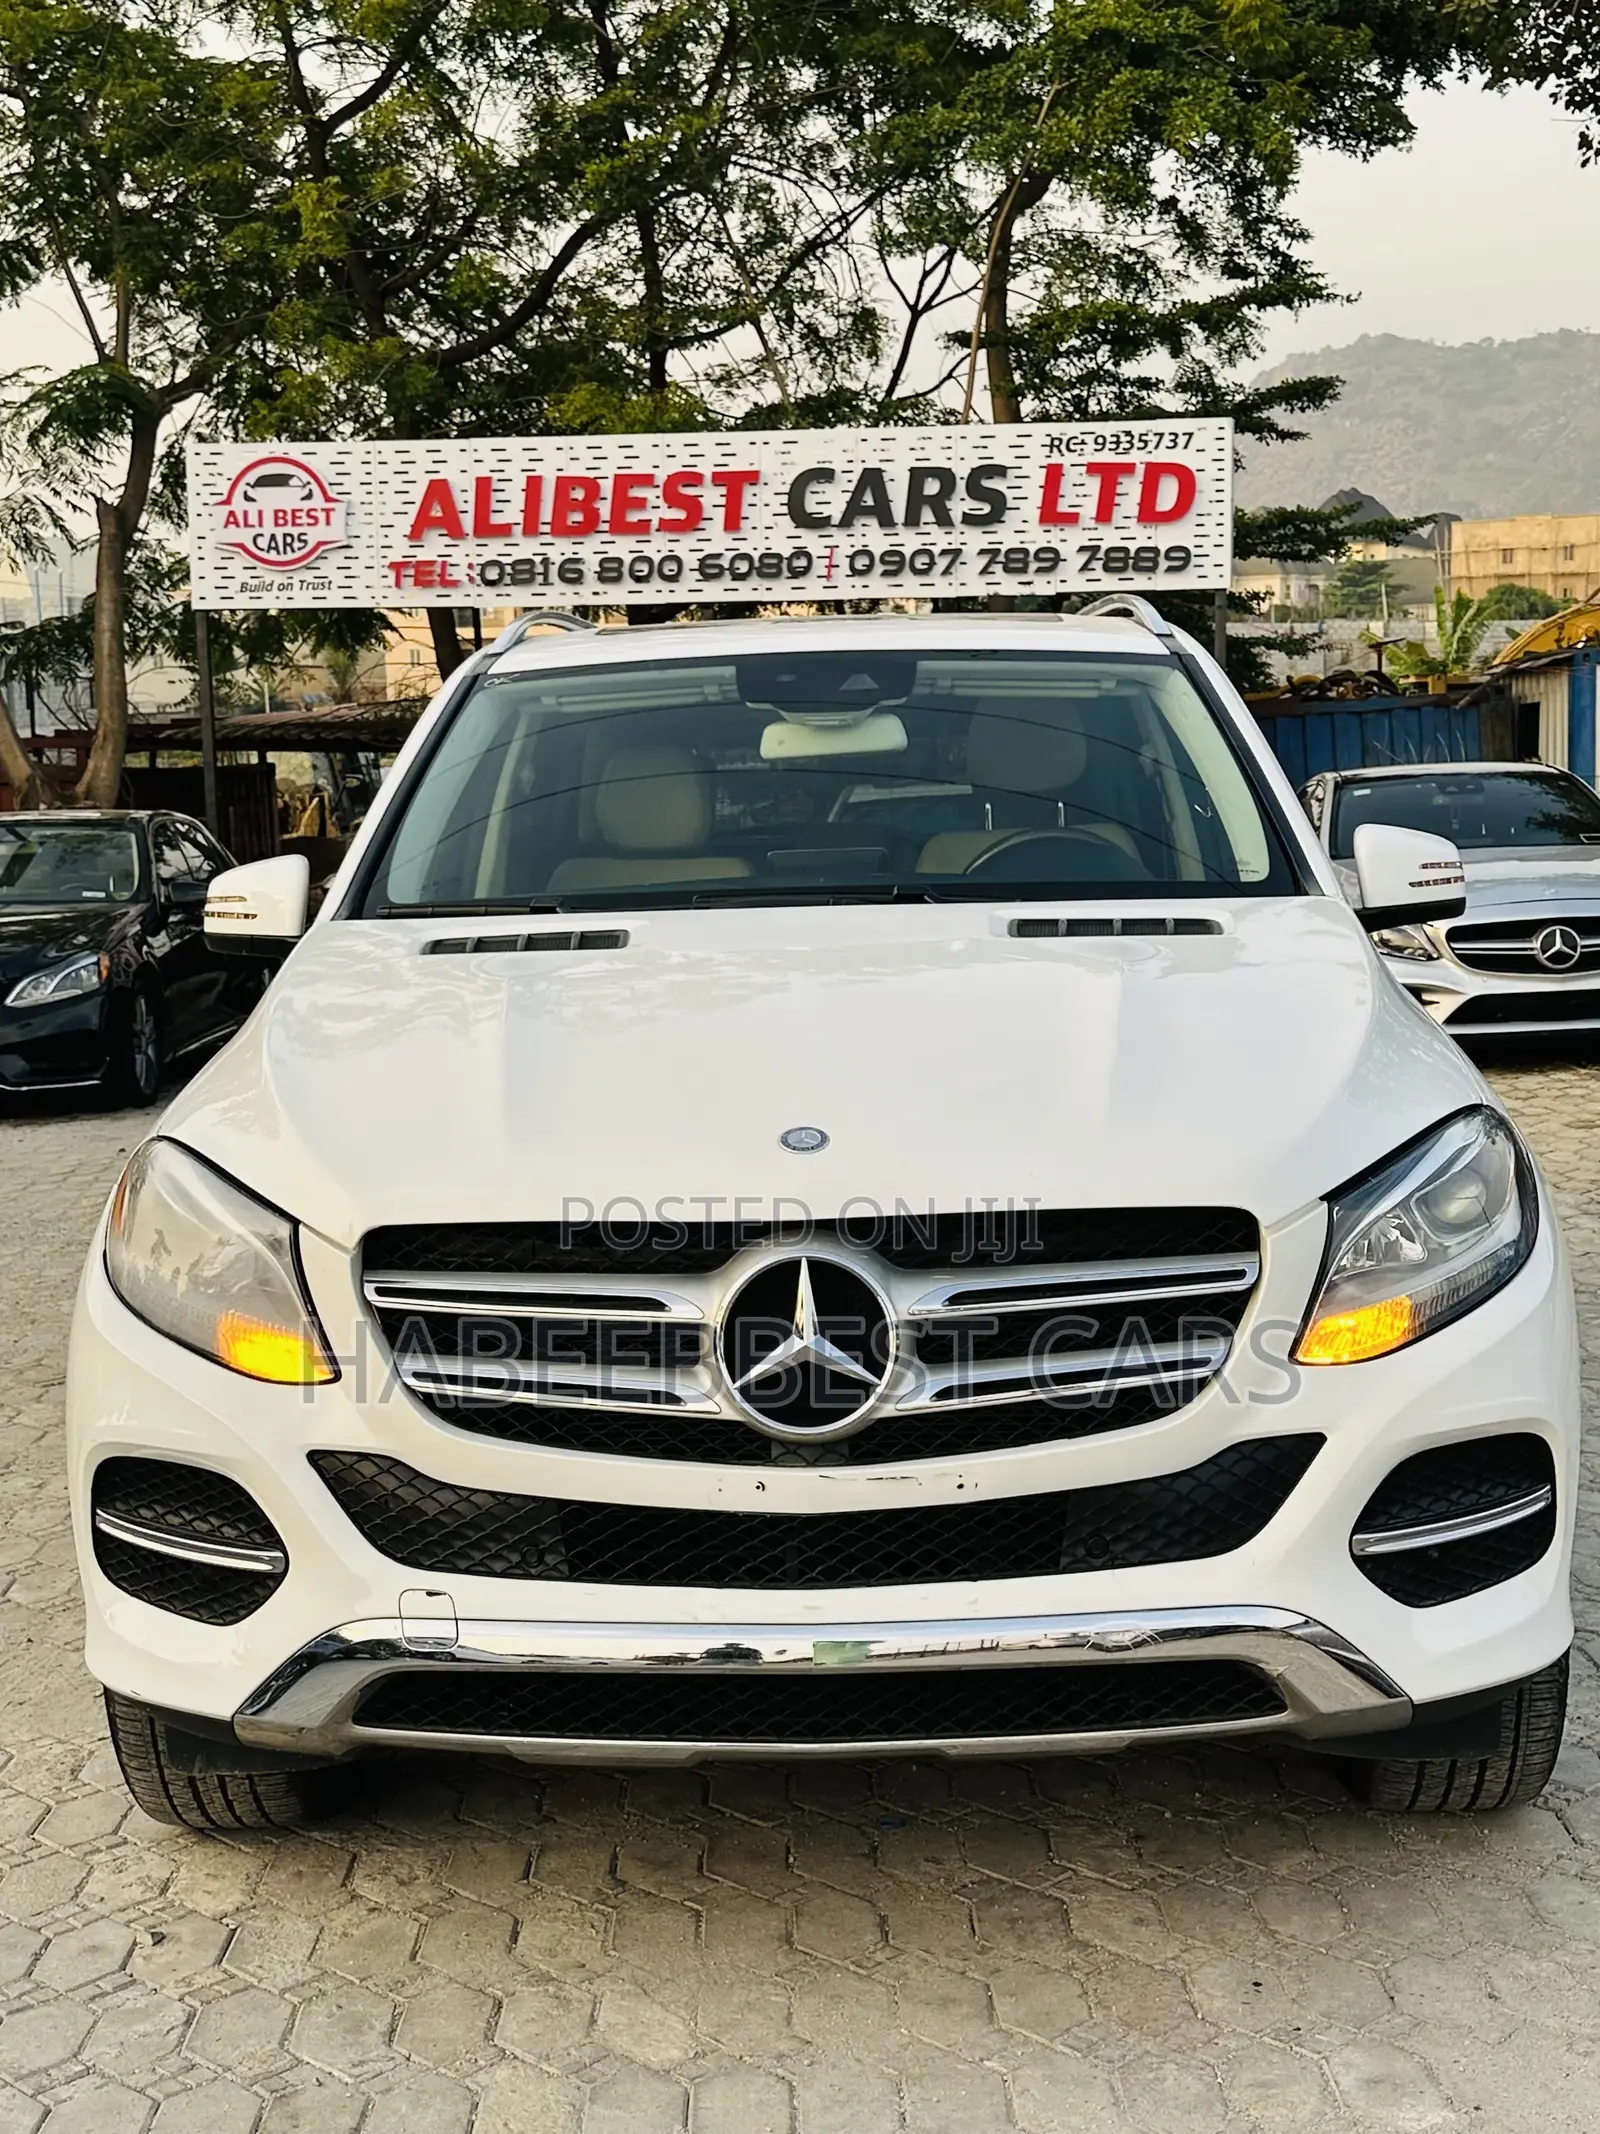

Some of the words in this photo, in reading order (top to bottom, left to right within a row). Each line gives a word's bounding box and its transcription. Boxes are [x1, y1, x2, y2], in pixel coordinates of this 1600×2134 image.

[408, 470, 760, 541] ALIBEST
[787, 463, 1009, 530] CARS
[1039, 462, 1197, 526] LTD
[223, 509, 264, 529] ALI
[273, 508, 335, 528] BEST
[252, 532, 309, 556] CARS
[480, 557, 584, 586] 0816
[598, 555, 683, 584] 800
[698, 550, 813, 580] 6080
[849, 548, 963, 578] 0907
[976, 545, 1061, 576] 789
[1076, 544, 1192, 574] 7889
[240, 580, 274, 593] Build
[277, 584, 294, 592] on
[299, 580, 333, 591] Trust
